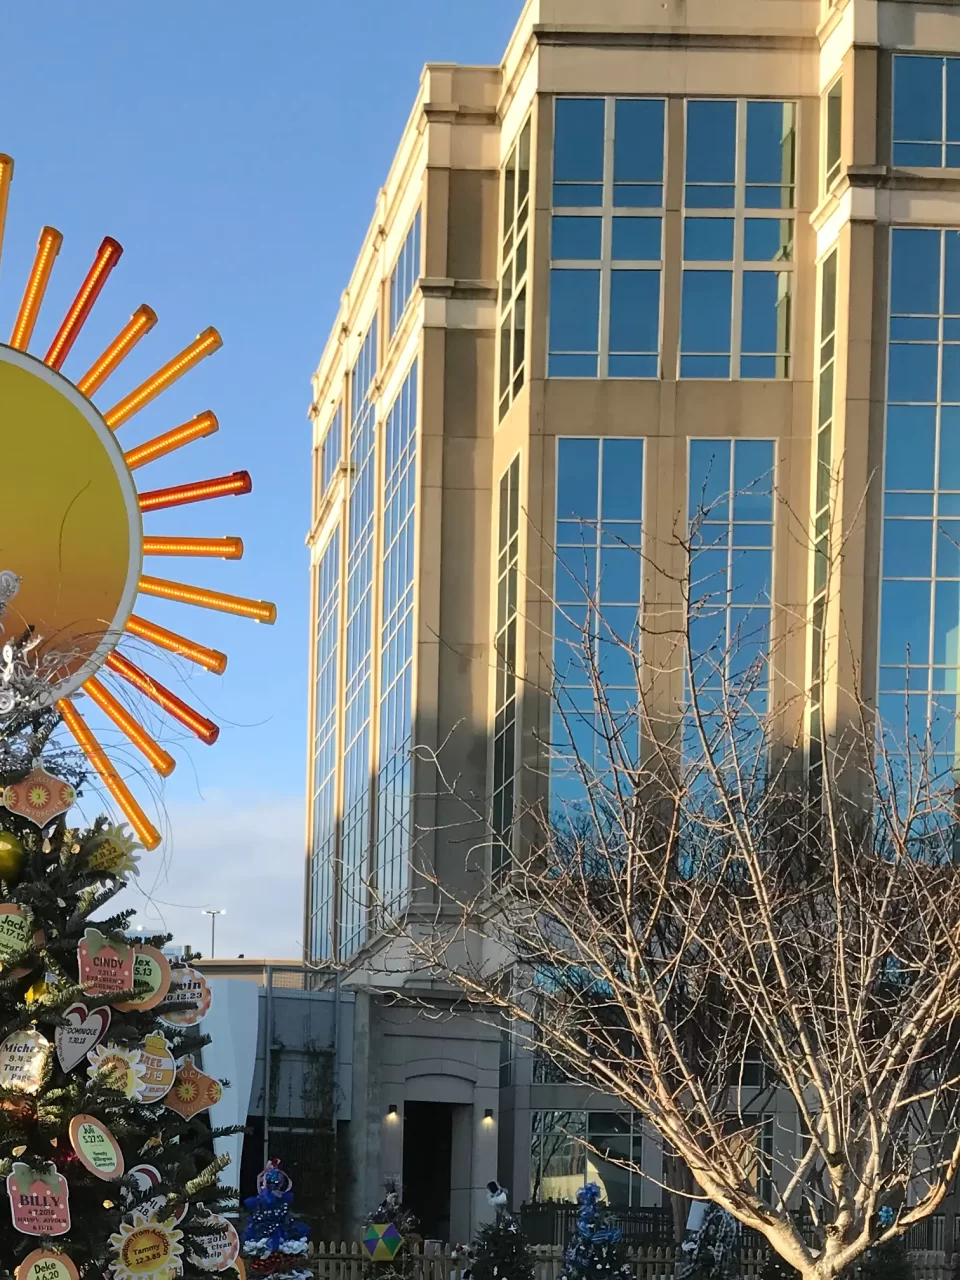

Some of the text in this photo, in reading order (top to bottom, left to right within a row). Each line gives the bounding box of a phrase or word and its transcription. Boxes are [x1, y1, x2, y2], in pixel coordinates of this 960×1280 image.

[1, 915, 25, 932] Jack
[93, 957, 123, 969] CINDY
[134, 956, 150, 966] lex
[67, 1027, 98, 1036] DOMINIQUE
[20, 1195, 60, 1206] BILLY
[134, 1243, 160, 1255] Tammy
[34, 1262, 56, 1274] Deke
